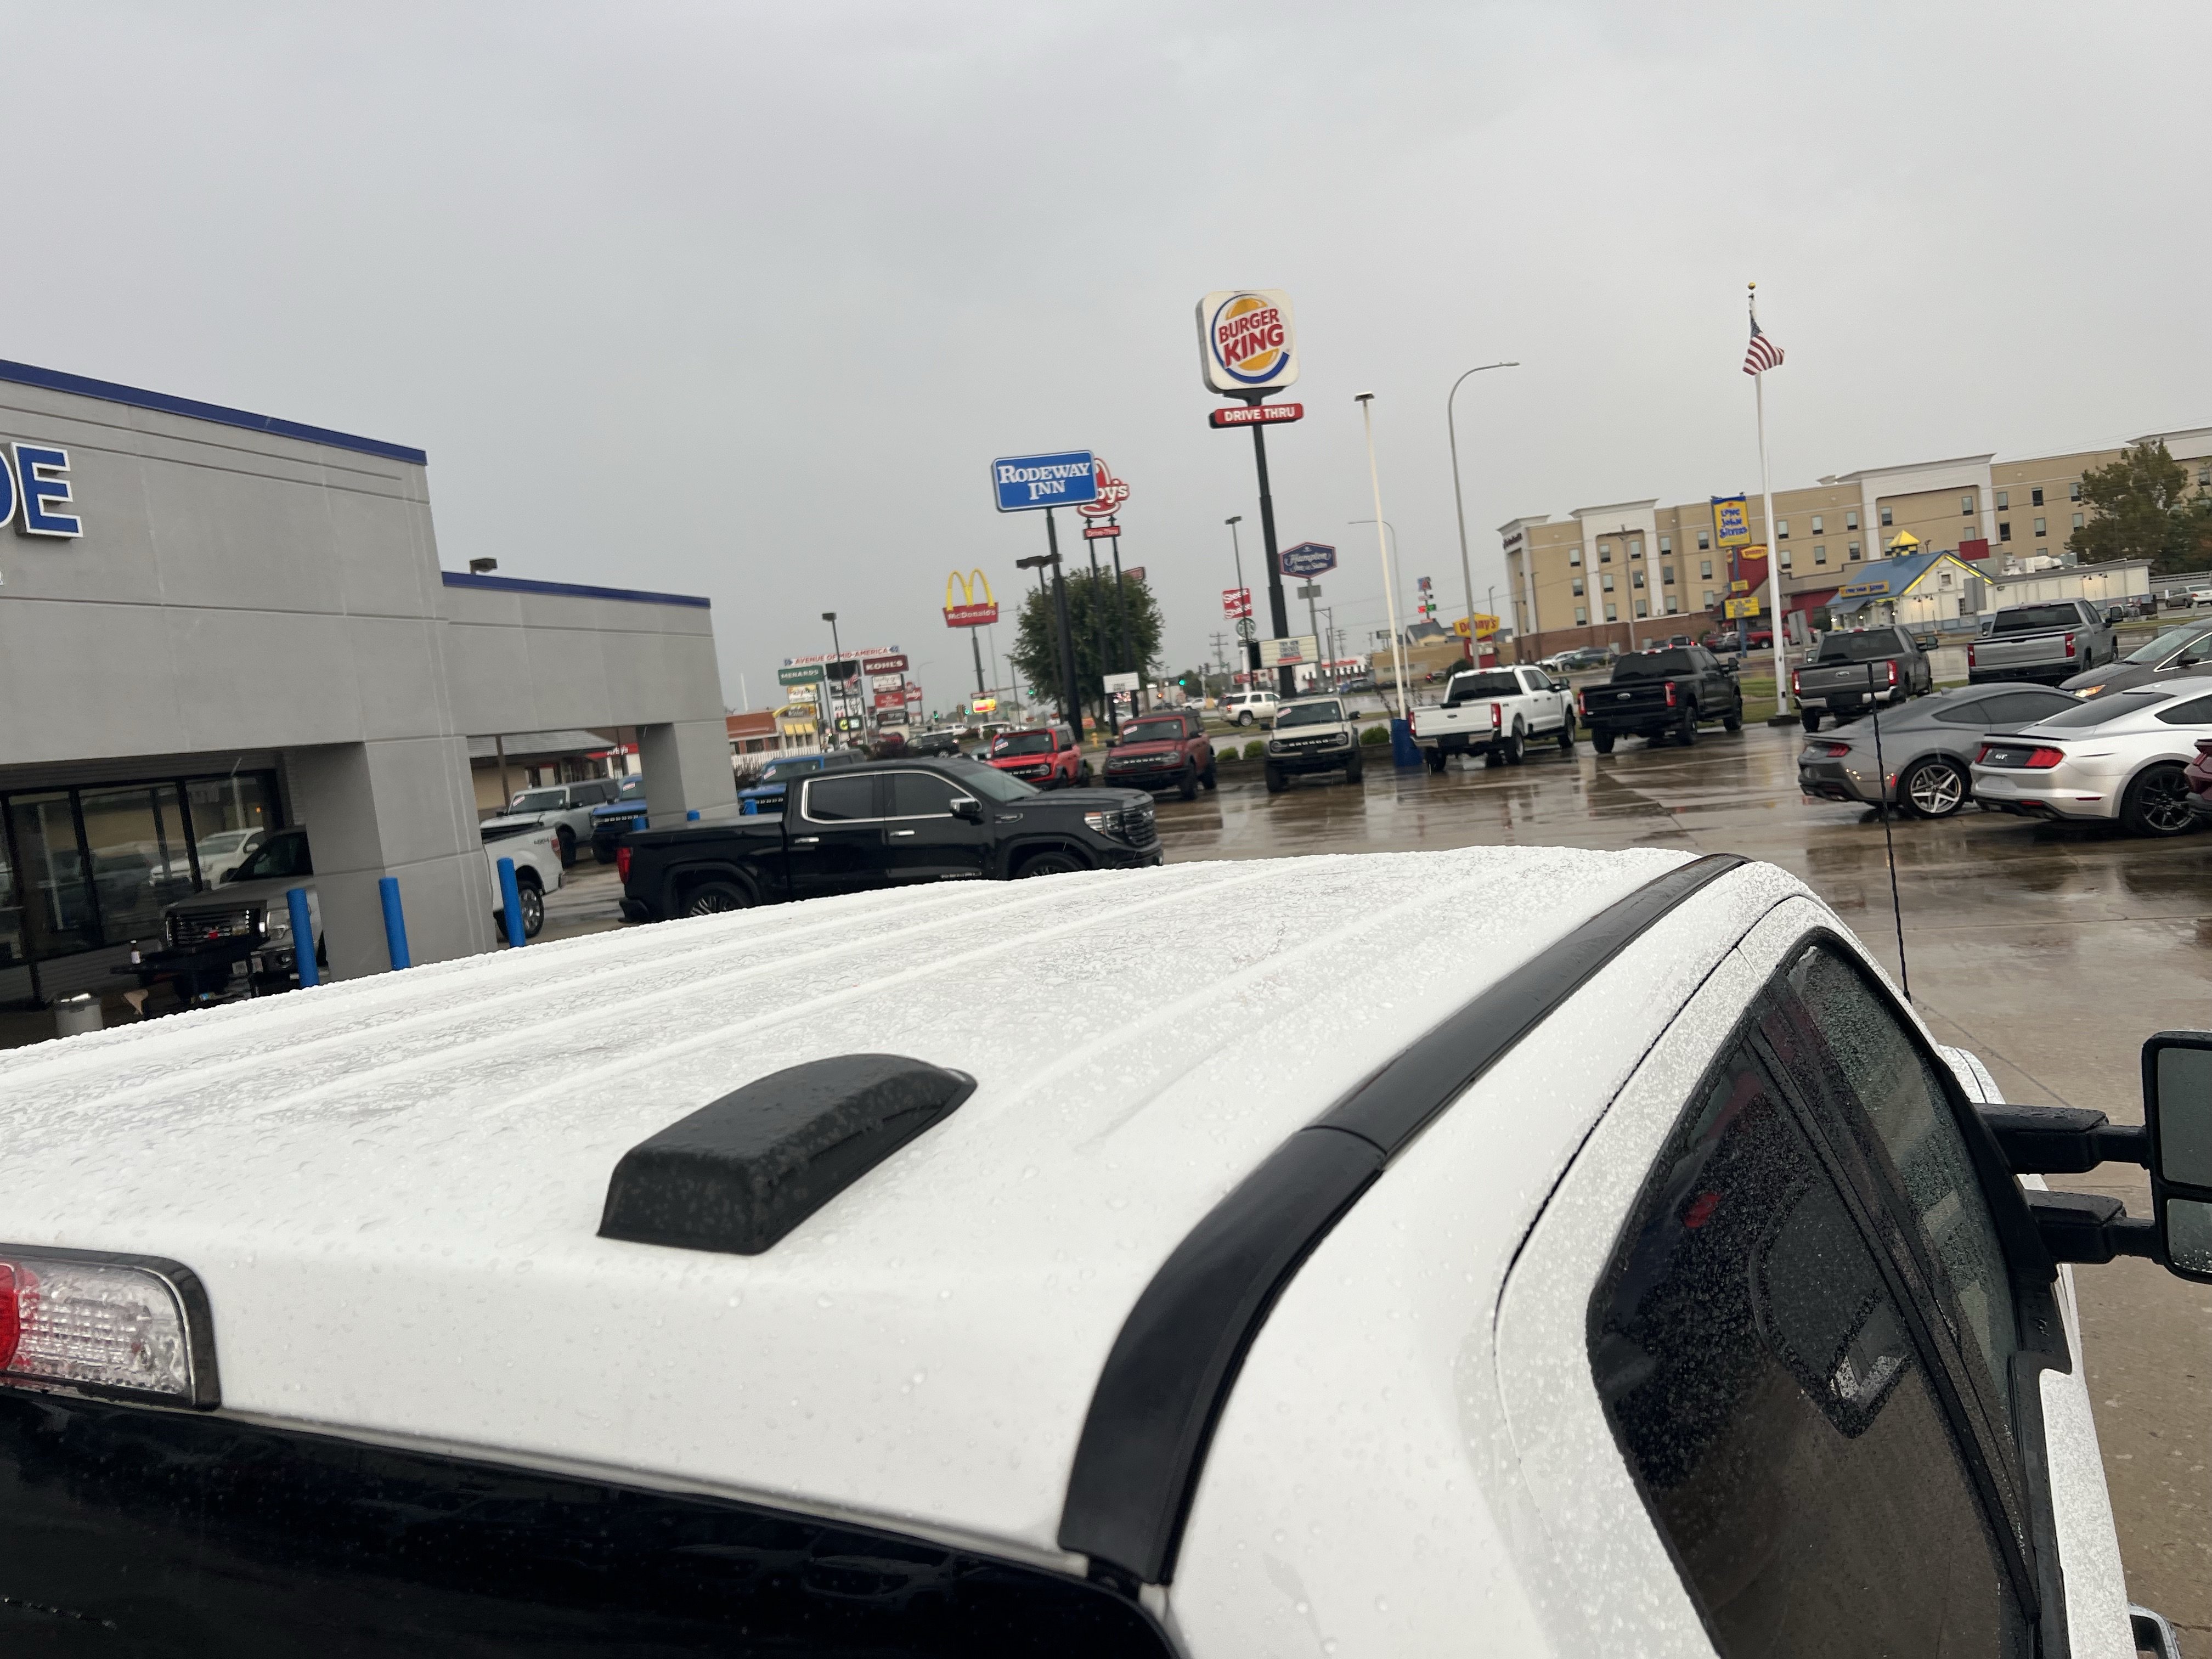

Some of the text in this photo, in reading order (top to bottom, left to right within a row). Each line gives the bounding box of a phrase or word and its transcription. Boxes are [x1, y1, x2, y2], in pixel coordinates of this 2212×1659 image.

[1218, 308, 1279, 343] BURGER
[1222, 324, 1284, 367] KING
[1224, 407, 1295, 421] DRIVE THRU
[0, 441, 83, 537] E
[1028, 480, 1066, 500] INN
[948, 610, 996, 620] McDonald's
[1459, 618, 1497, 633] Deny's
[795, 655, 825, 664] AVENUE
